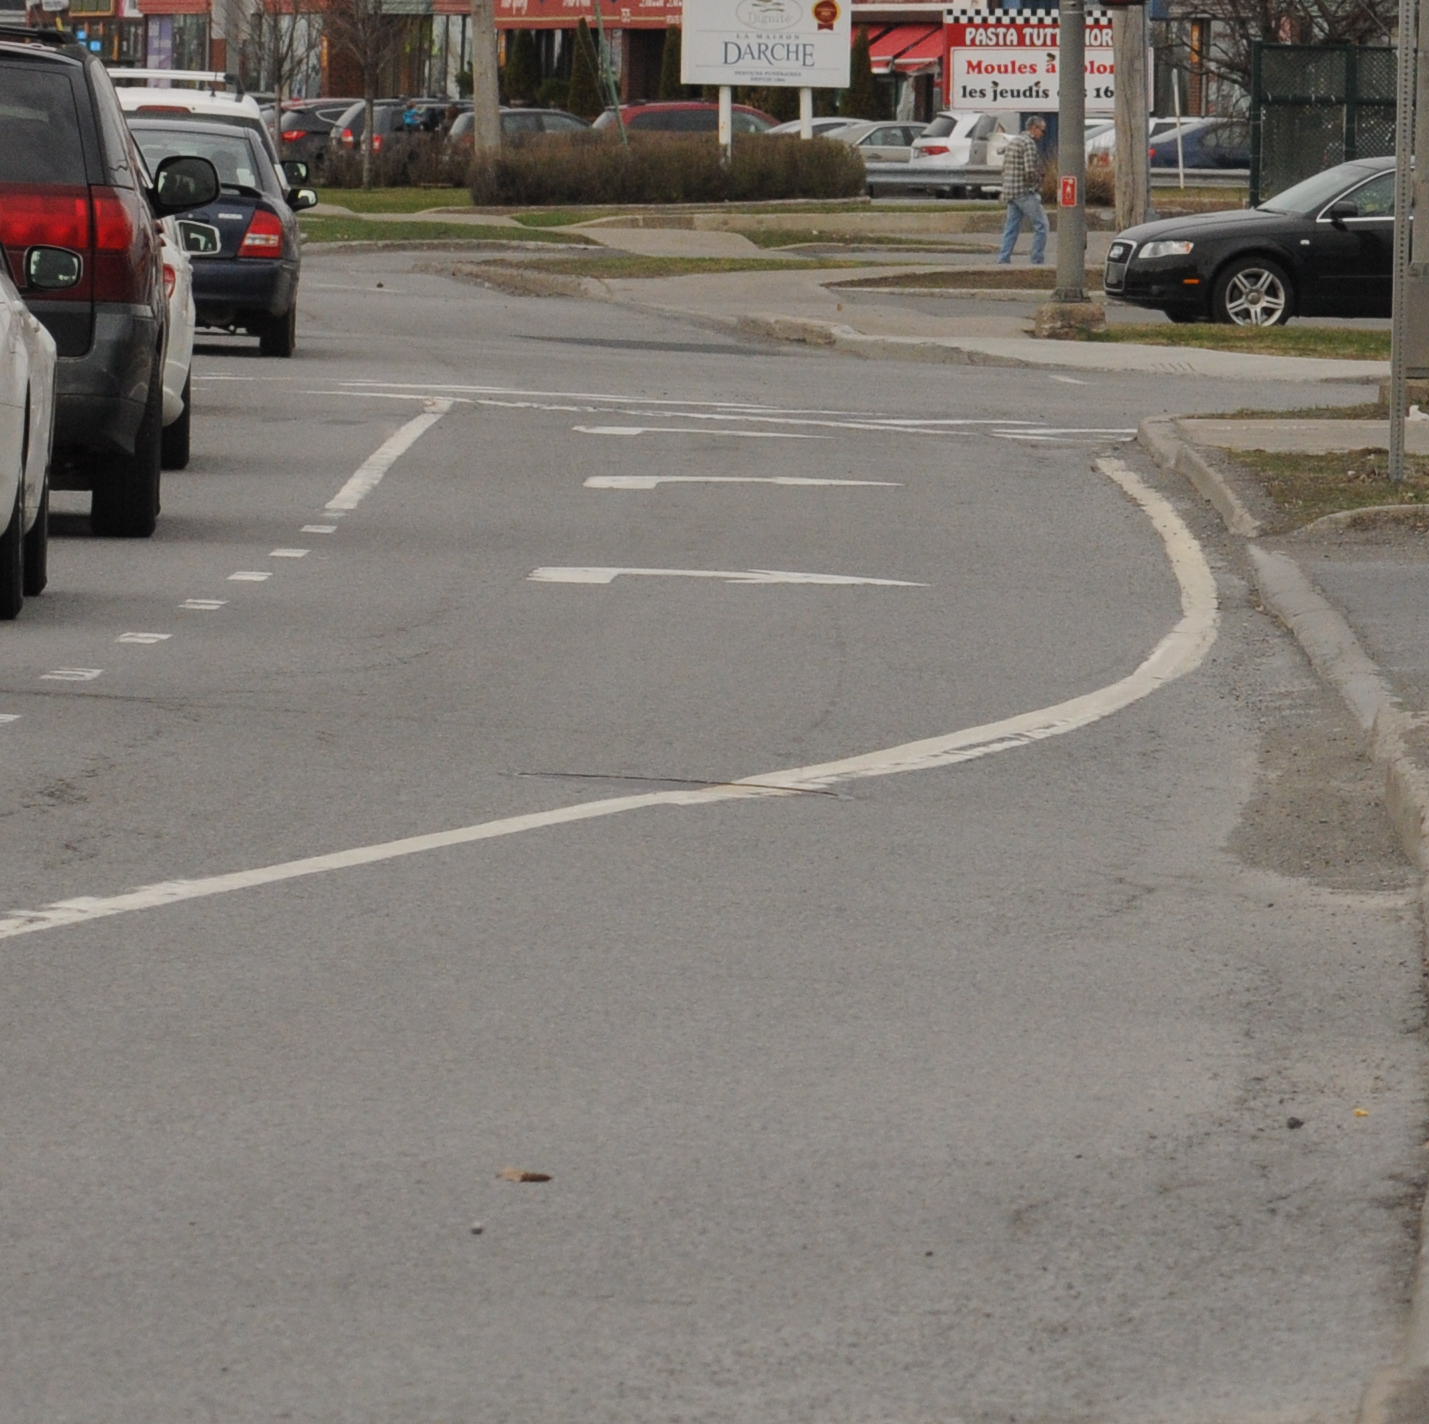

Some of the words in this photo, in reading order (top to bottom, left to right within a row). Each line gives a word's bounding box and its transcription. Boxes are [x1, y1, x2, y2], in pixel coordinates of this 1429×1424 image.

[965, 27, 1019, 46] PASTA
[723, 41, 815, 67] DARCHE
[966, 59, 1038, 75] Moules
[961, 85, 987, 99] les
[991, 81, 1050, 102] jeudis
